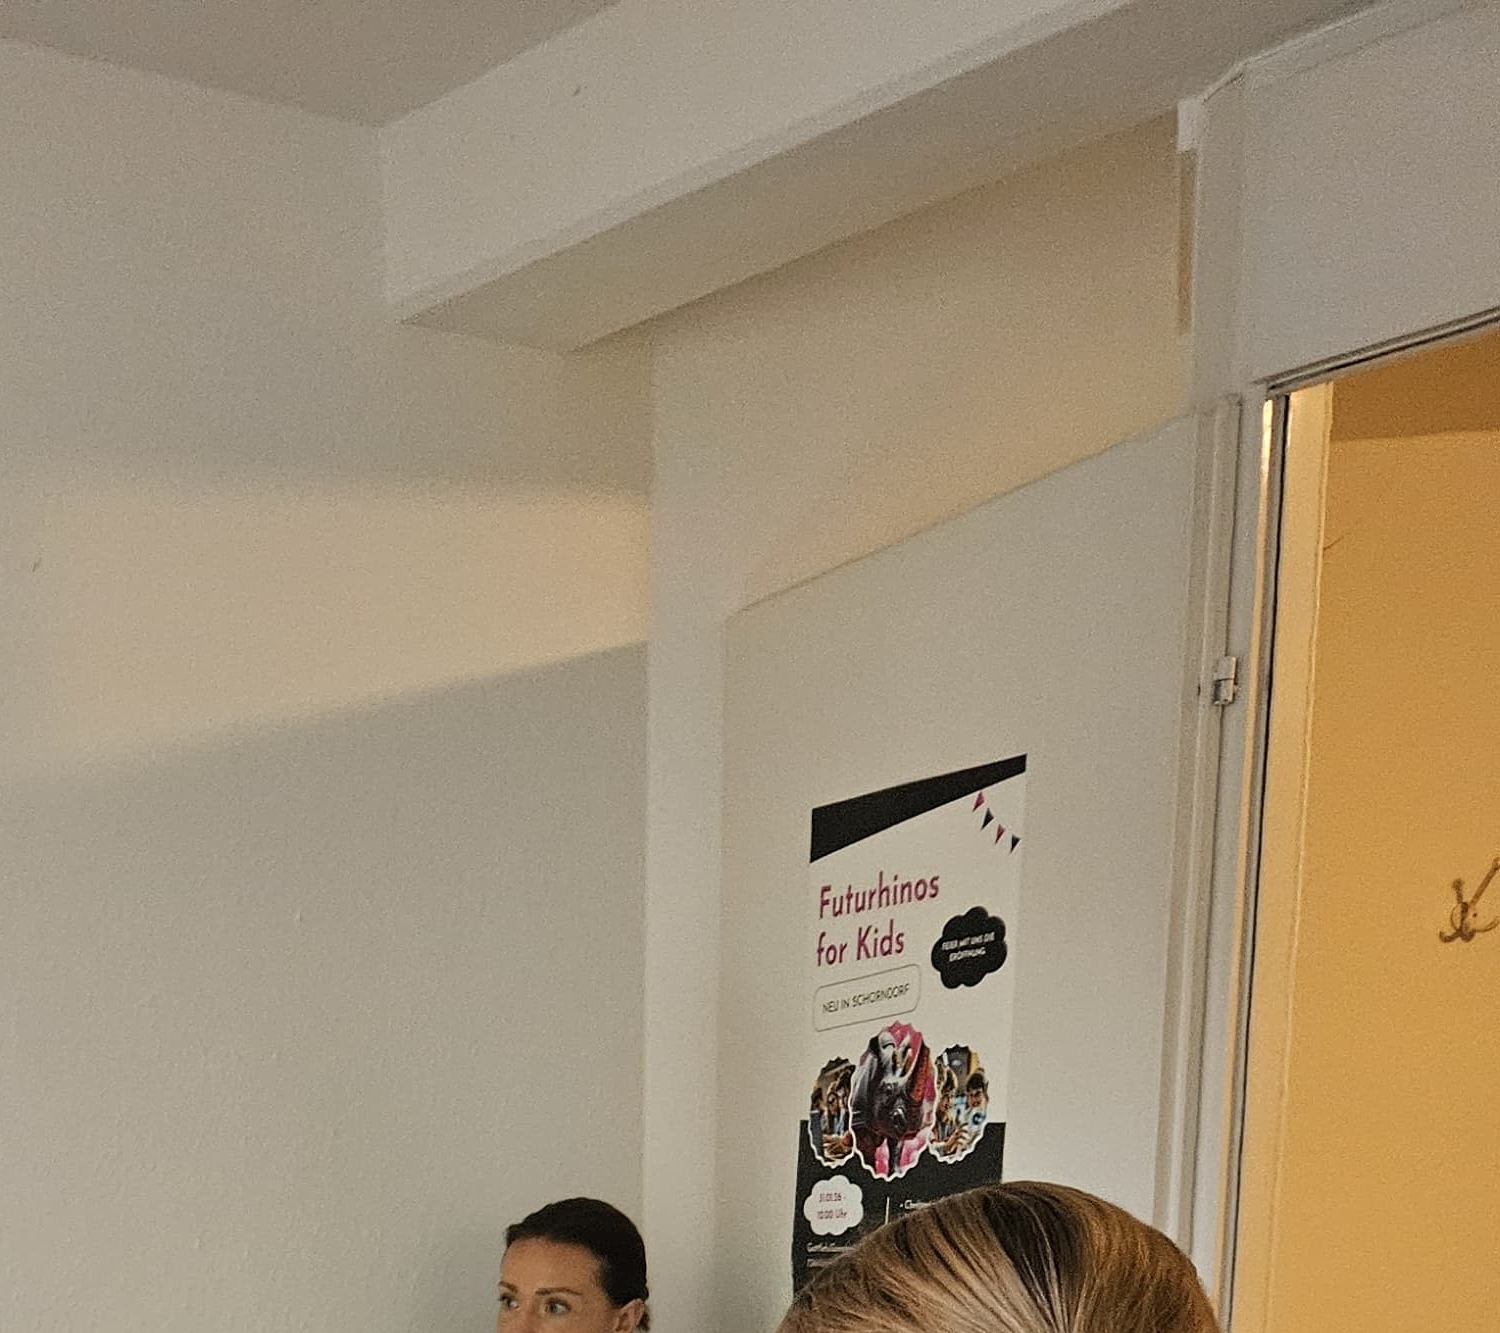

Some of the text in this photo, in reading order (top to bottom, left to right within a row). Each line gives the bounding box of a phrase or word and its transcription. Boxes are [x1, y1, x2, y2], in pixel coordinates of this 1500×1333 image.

[819, 871, 940, 919] Futurhinos
[817, 918, 905, 967] for Kids
[822, 983, 911, 1014] NEU IN SCHORNDORF
